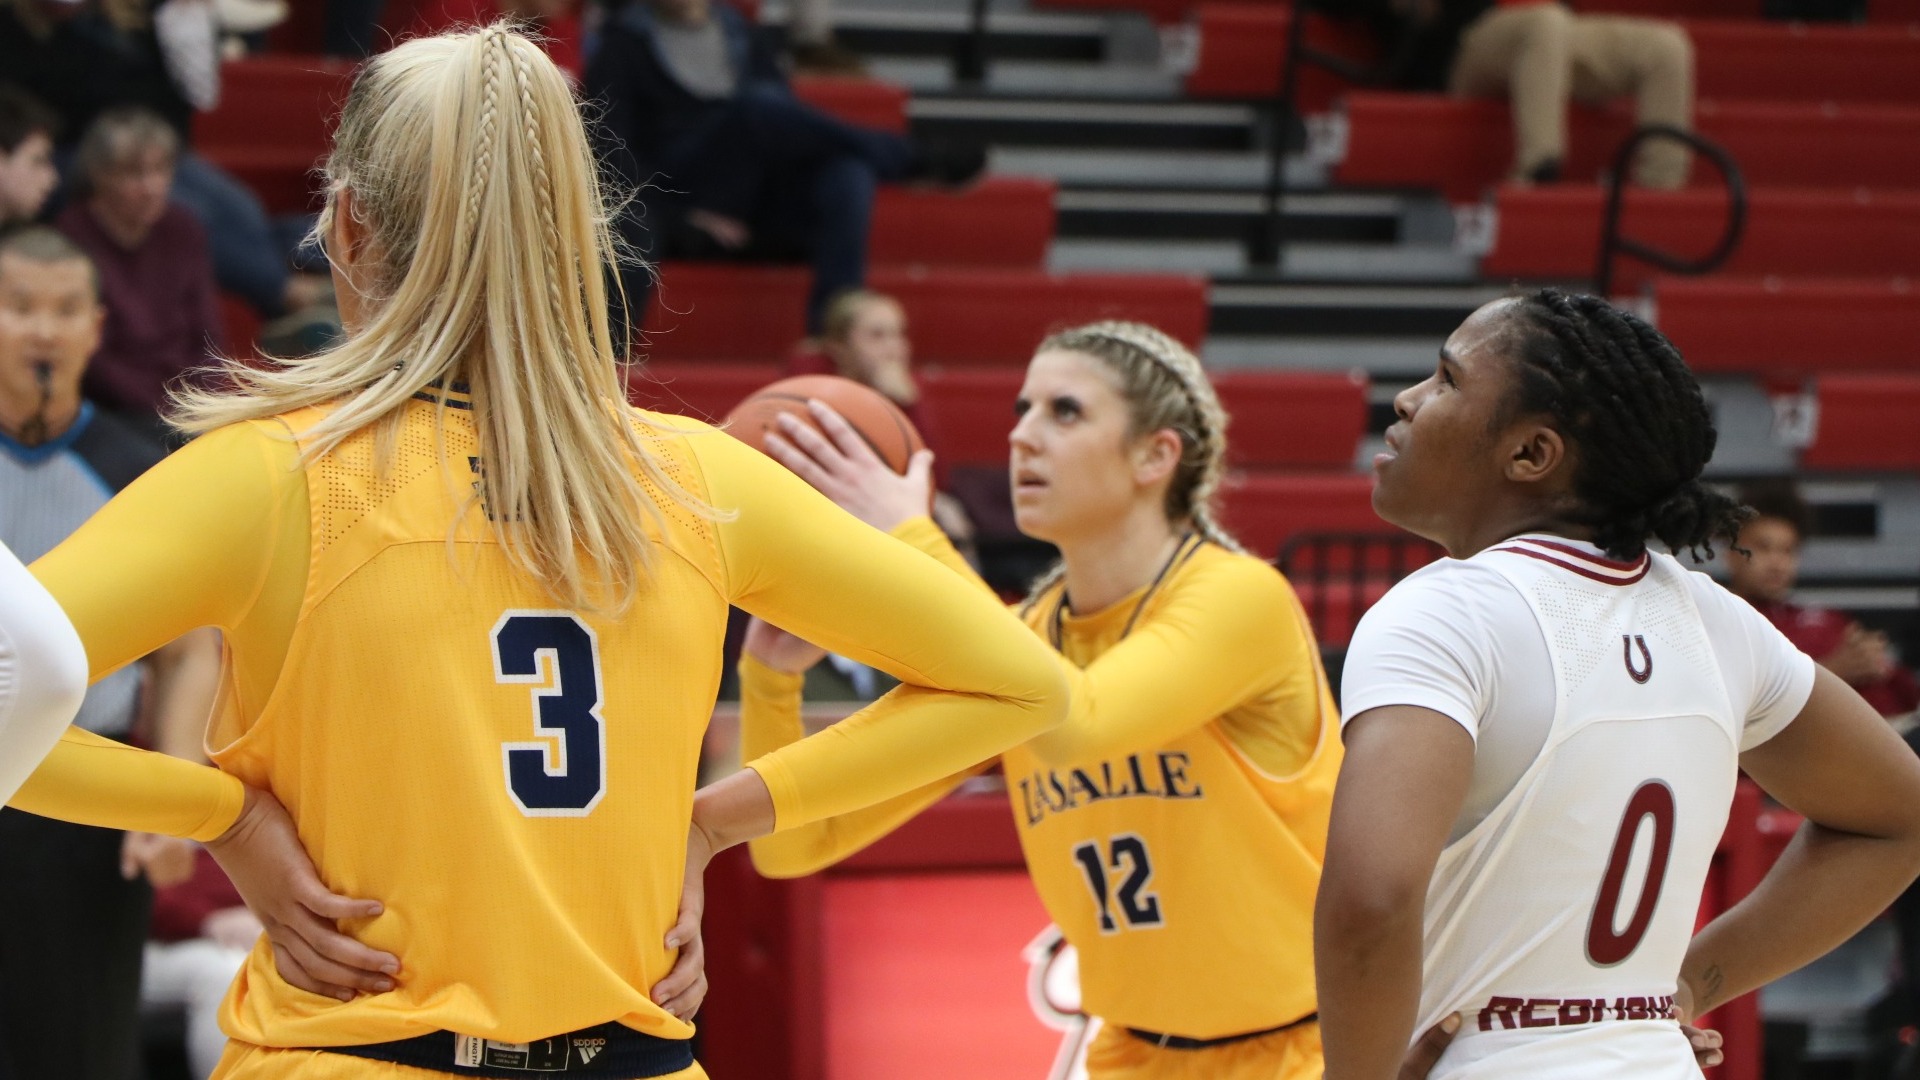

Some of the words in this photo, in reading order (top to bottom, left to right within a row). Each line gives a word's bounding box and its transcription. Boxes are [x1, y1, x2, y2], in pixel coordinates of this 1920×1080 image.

[489, 608, 606, 818] 3
[1073, 831, 1166, 937] 12
[1584, 777, 1677, 969] 0
[573, 1037, 606, 1048] adidas
